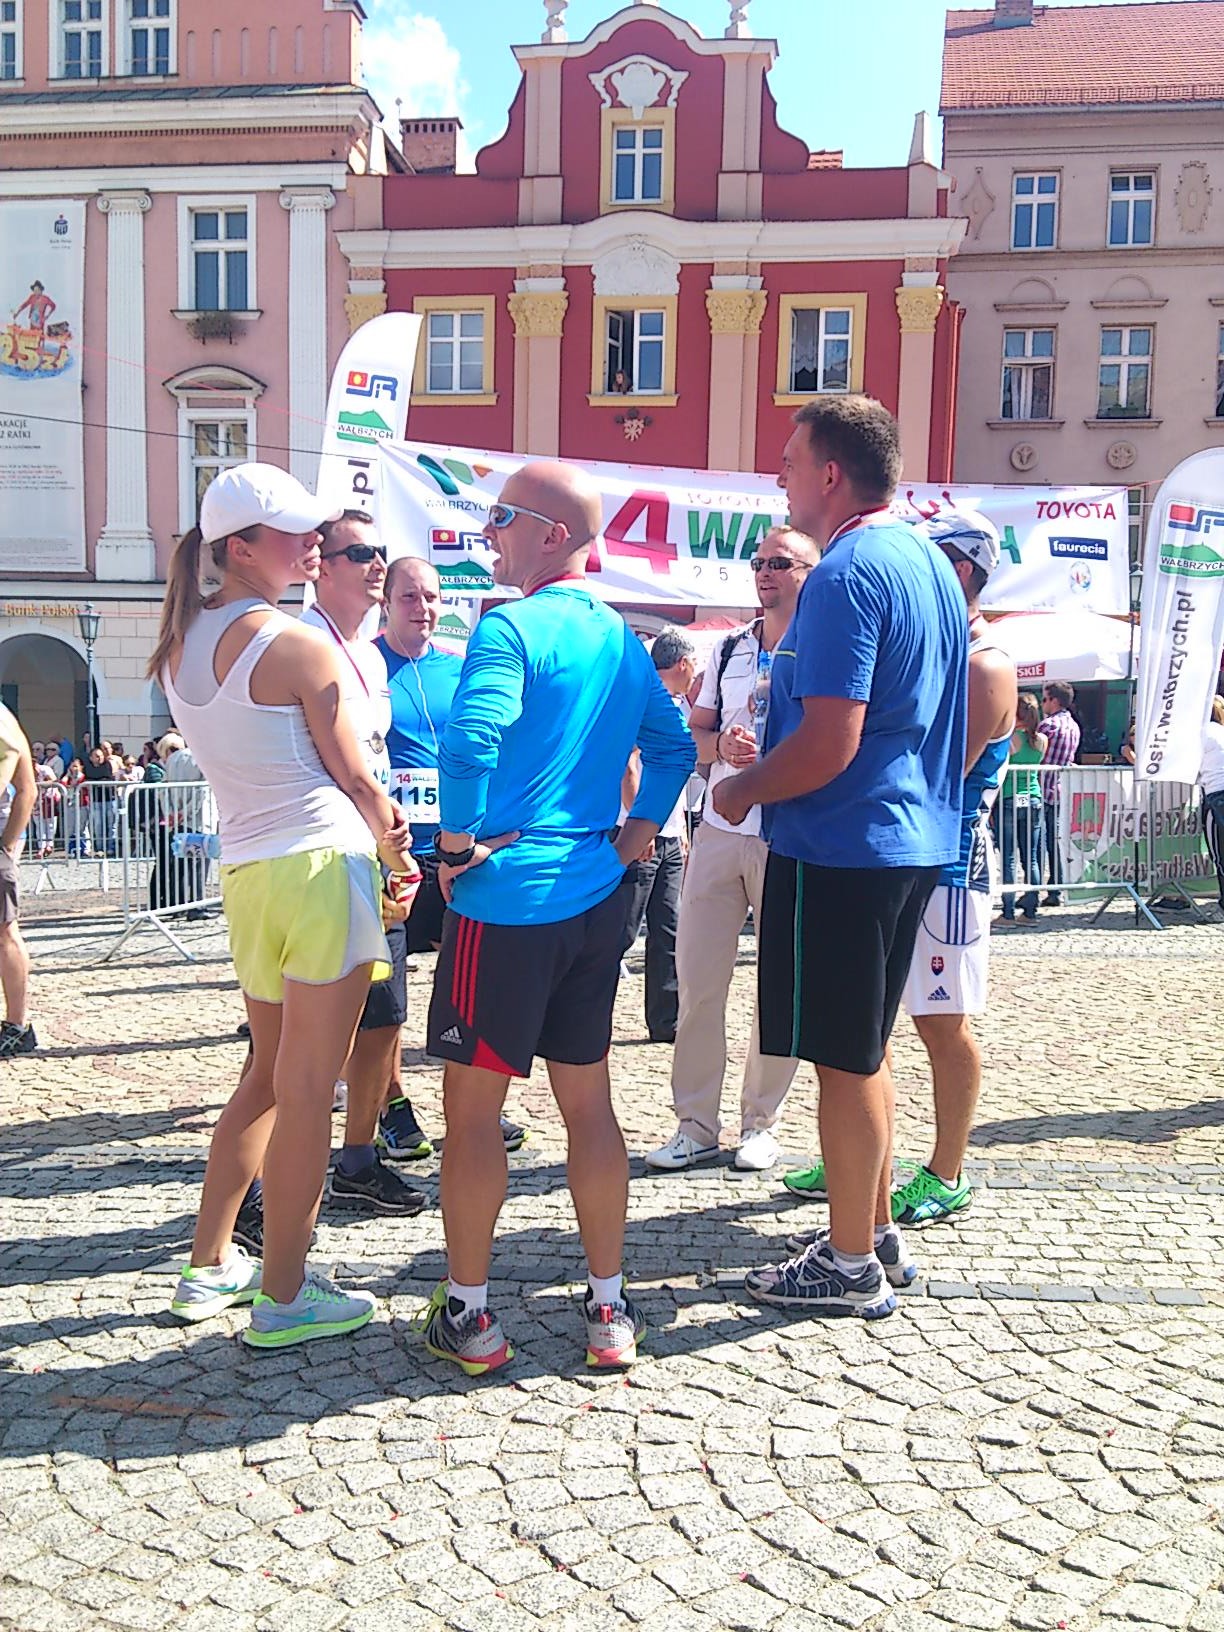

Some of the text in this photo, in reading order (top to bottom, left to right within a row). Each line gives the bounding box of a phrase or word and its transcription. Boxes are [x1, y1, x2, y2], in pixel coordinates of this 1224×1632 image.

[1036, 501, 1117, 520] TOYOTA
[1053, 541, 1106, 555] faurecia
[396, 773, 412, 784] 14
[391, 786, 437, 806] 115
